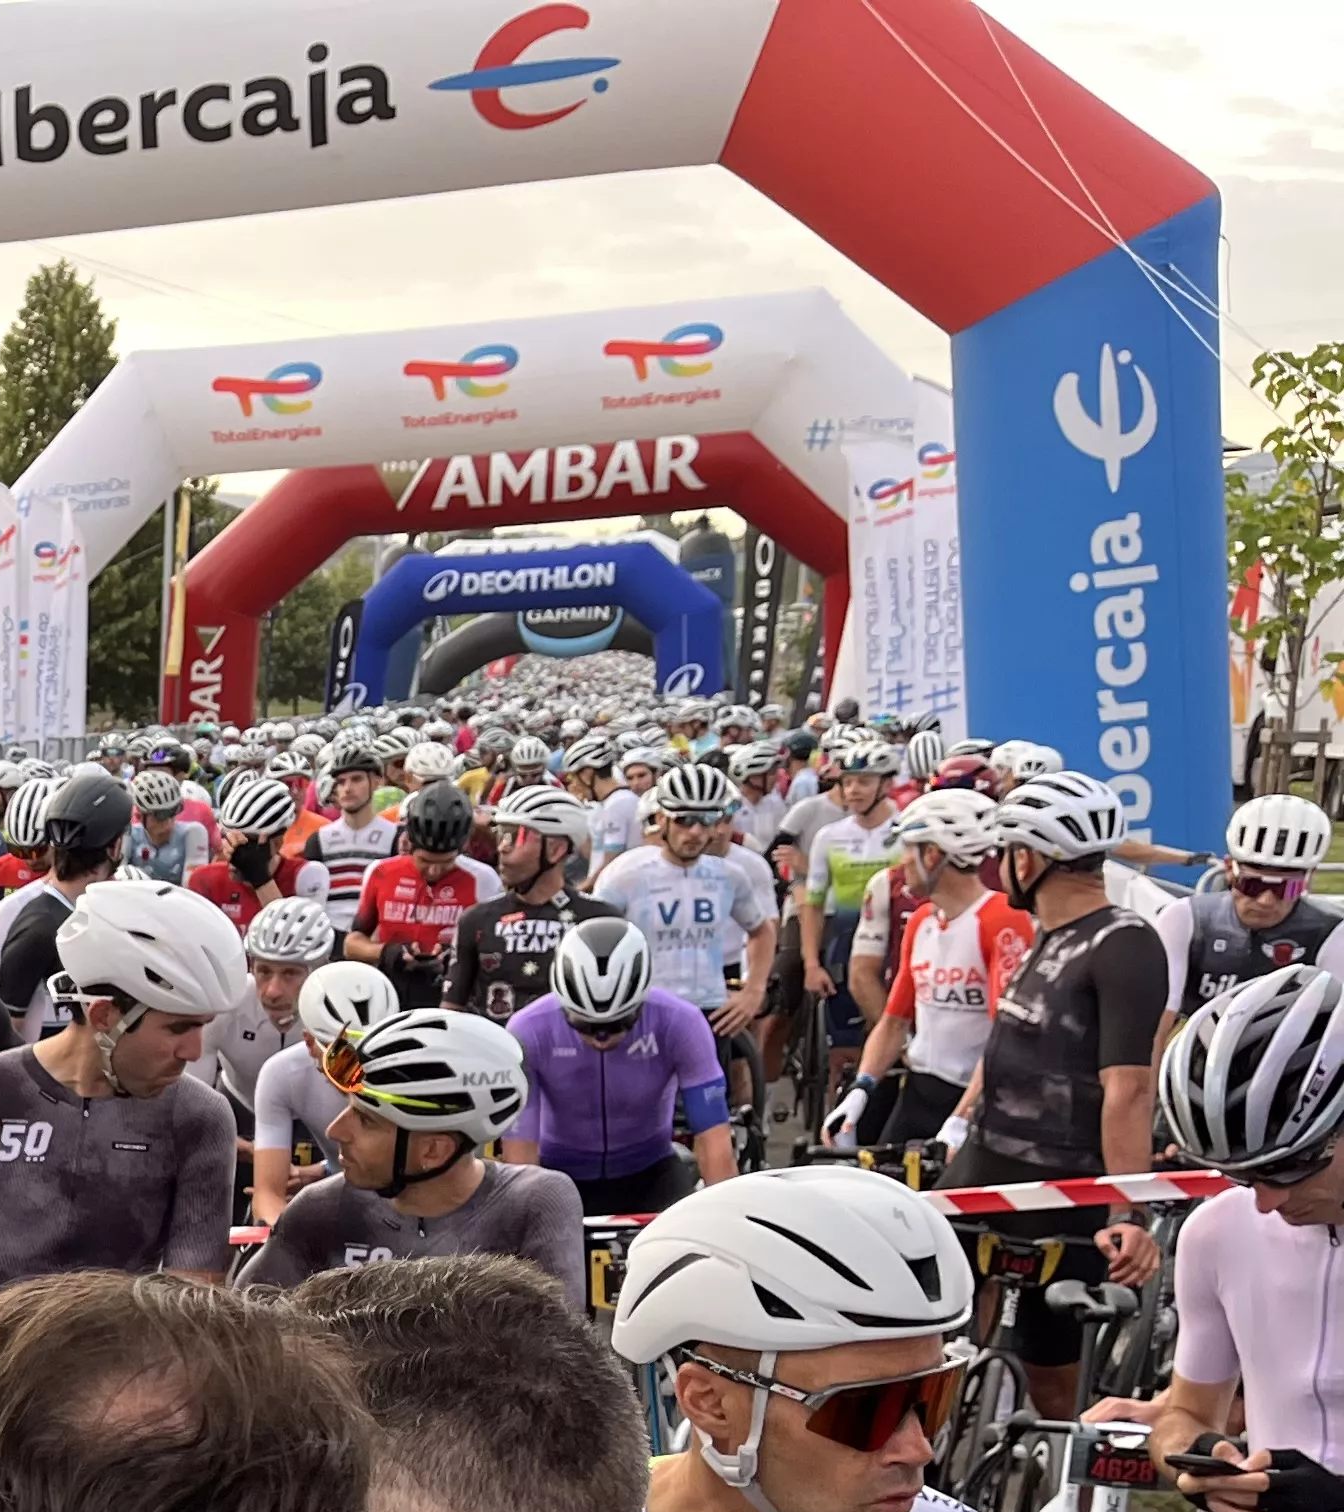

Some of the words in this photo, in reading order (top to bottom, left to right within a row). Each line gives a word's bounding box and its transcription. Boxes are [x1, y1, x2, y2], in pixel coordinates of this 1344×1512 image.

[601, 387, 722, 411] TotalEnergies
[402, 408, 518, 430] TotalEnergies
[209, 424, 322, 445] TotalEnergies
[431, 434, 708, 511] AMBAR
[461, 561, 616, 596] DECATHLON
[526, 605, 611, 622] GARMIN
[189, 655, 224, 728] BAR
[494, 919, 576, 937] FACTORY
[504, 933, 561, 953] TEAM
[462, 1070, 513, 1087] KASK
[1291, 1056, 1328, 1125] MET
[1090, 1456, 1156, 1483] 4628
